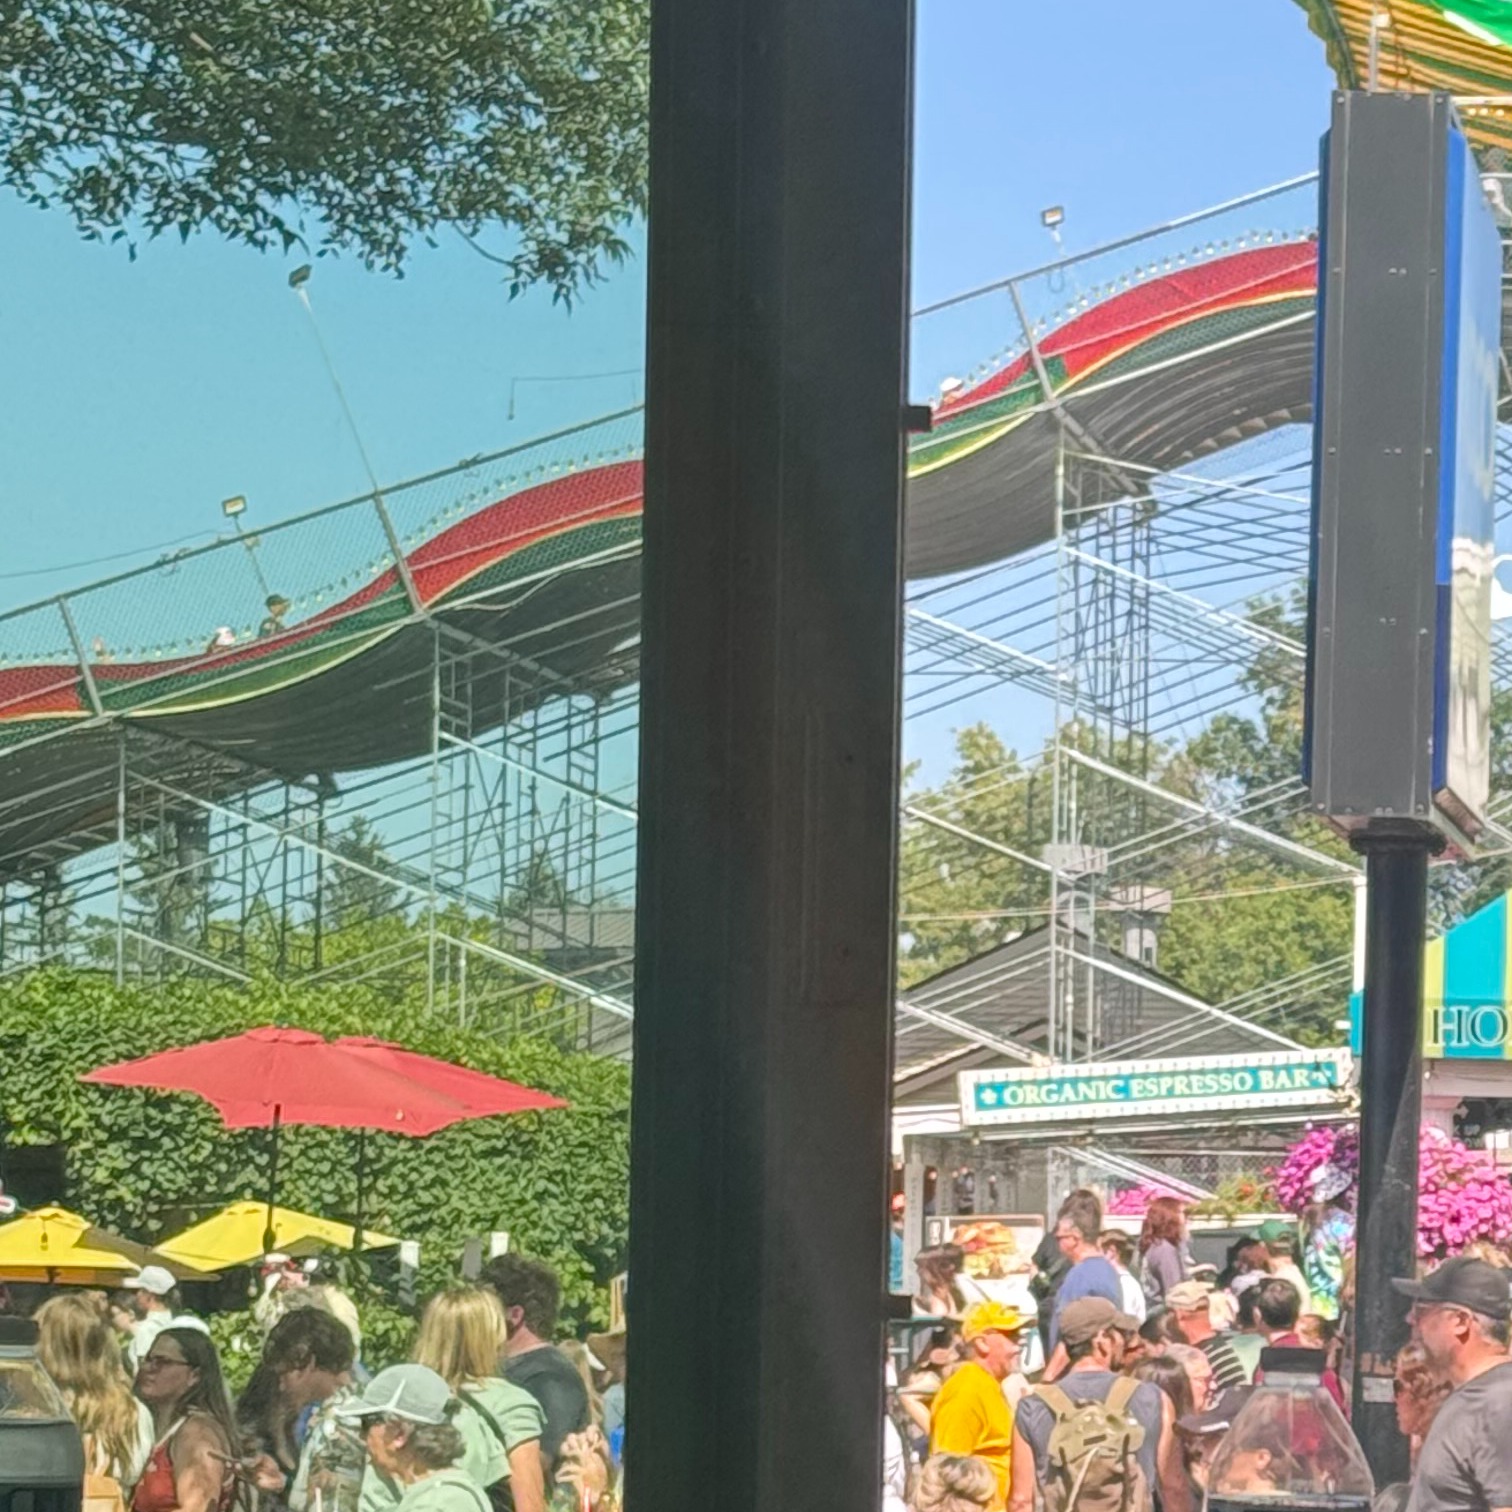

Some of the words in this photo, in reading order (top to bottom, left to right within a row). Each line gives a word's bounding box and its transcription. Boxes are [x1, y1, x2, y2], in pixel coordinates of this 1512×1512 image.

[1003, 1079, 1125, 1106] ORGANIC
[1129, 1072, 1254, 1099] ESPRESSO
[1258, 1068, 1312, 1091] BAR
